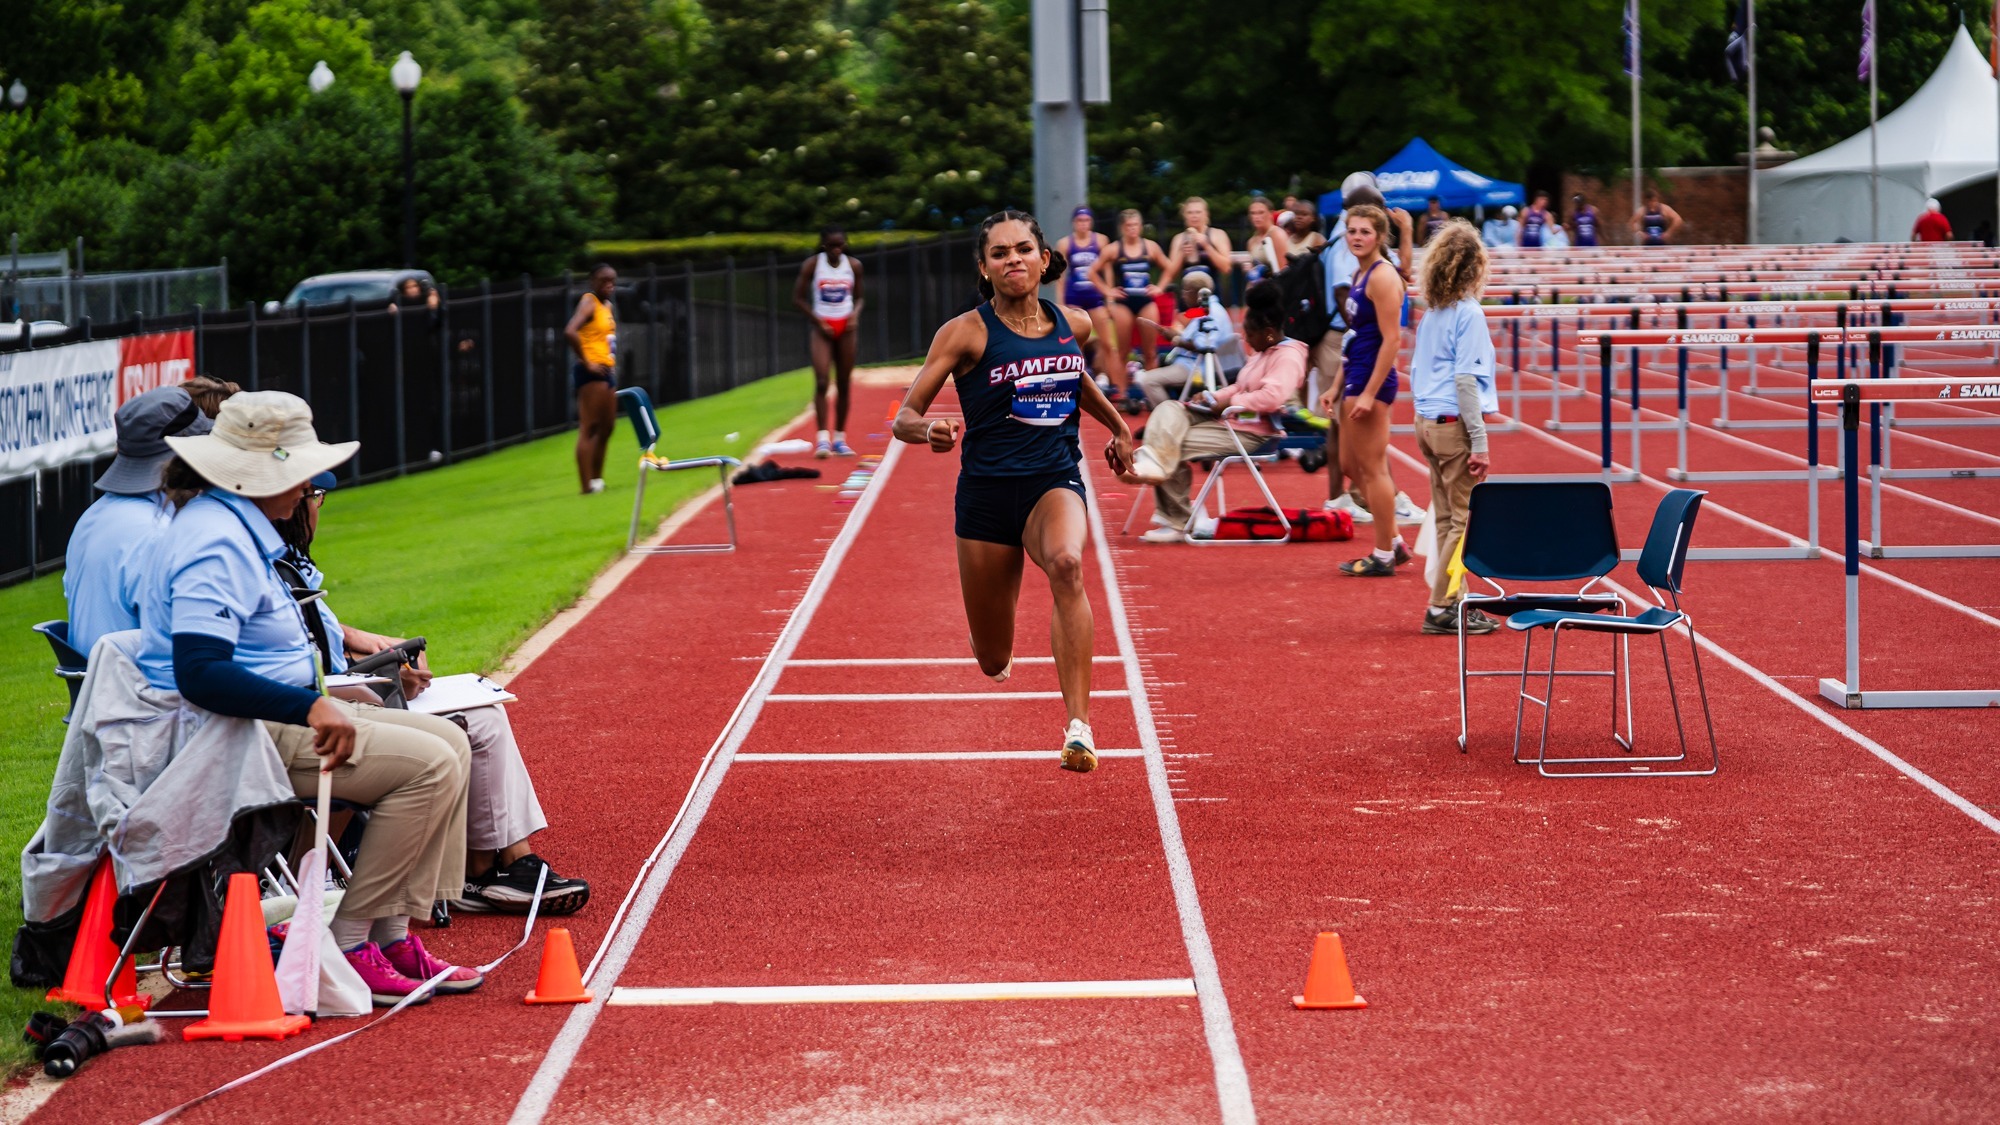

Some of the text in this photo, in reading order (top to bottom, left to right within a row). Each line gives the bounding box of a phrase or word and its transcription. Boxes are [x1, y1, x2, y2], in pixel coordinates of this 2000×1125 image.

[1739, 306, 1785, 314] SAMFORD
[1944, 302, 1990, 310] SAMFORD
[1681, 333, 1740, 343] SAMFORD
[1814, 389, 1839, 397] UCS
[1960, 384, 2000, 397] SAM
[53, 369, 114, 441] CONFERENCE
[463, 881, 485, 893] OK
